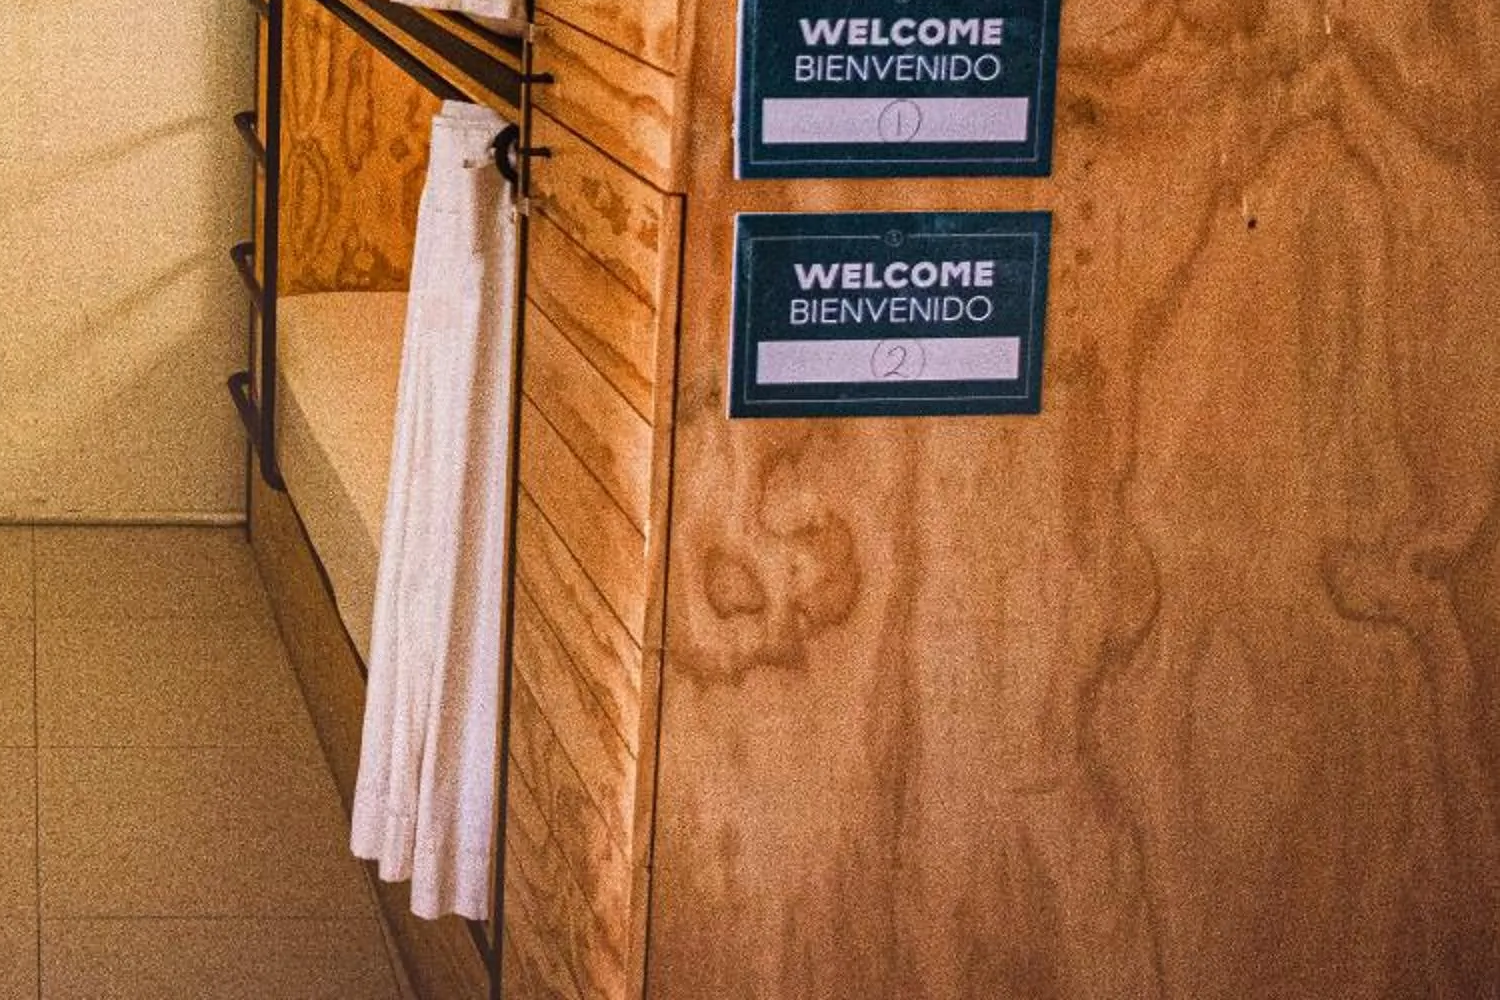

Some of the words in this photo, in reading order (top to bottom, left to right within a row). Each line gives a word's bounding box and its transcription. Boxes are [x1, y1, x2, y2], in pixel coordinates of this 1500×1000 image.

[799, 18, 1003, 46] WELCOME
[795, 54, 1001, 82] BIENVENIDO
[794, 260, 995, 290] WELCOME
[790, 295, 993, 325] BIENVENIDO
